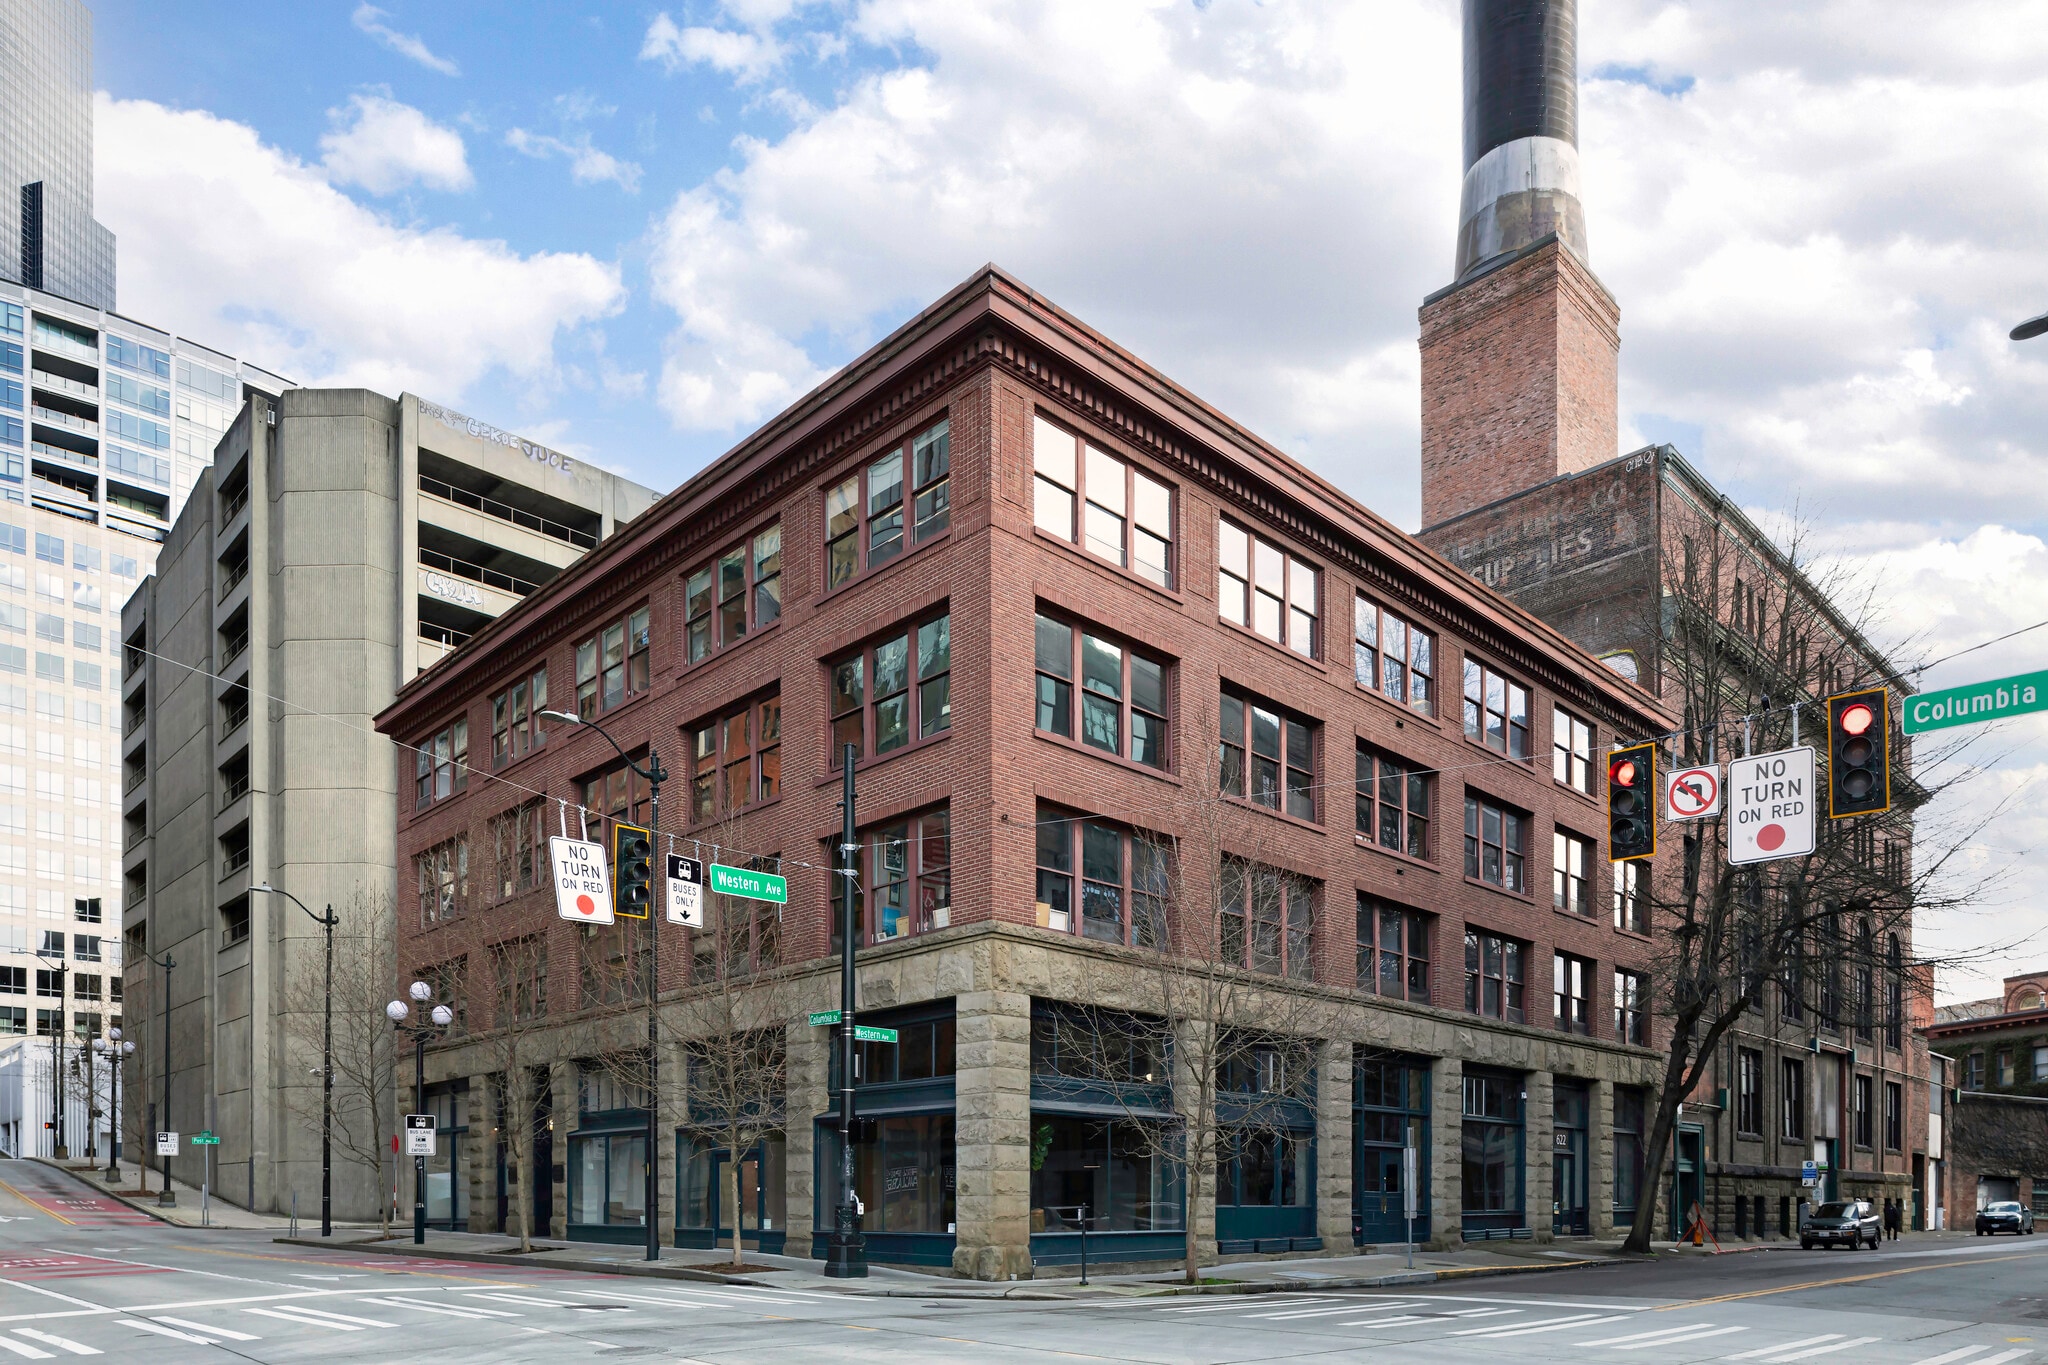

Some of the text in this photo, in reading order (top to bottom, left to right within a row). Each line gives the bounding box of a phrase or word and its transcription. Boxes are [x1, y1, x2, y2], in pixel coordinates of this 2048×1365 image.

[1913, 683, 2037, 724] Columbia
[1755, 758, 1787, 781] NO
[1741, 778, 1802, 805] TURN
[1738, 800, 1805, 825] ON RED
[568, 844, 589, 861] NO
[561, 860, 601, 880] TURN
[561, 877, 604, 895] ON RED
[672, 882, 697, 897] BUSES
[717, 870, 782, 896] Western Ave
[675, 895, 695, 908] ONLY
[810, 1013, 832, 1025] Columbia
[855, 1028, 881, 1040] Western
[1556, 1134, 1566, 1146] 622
